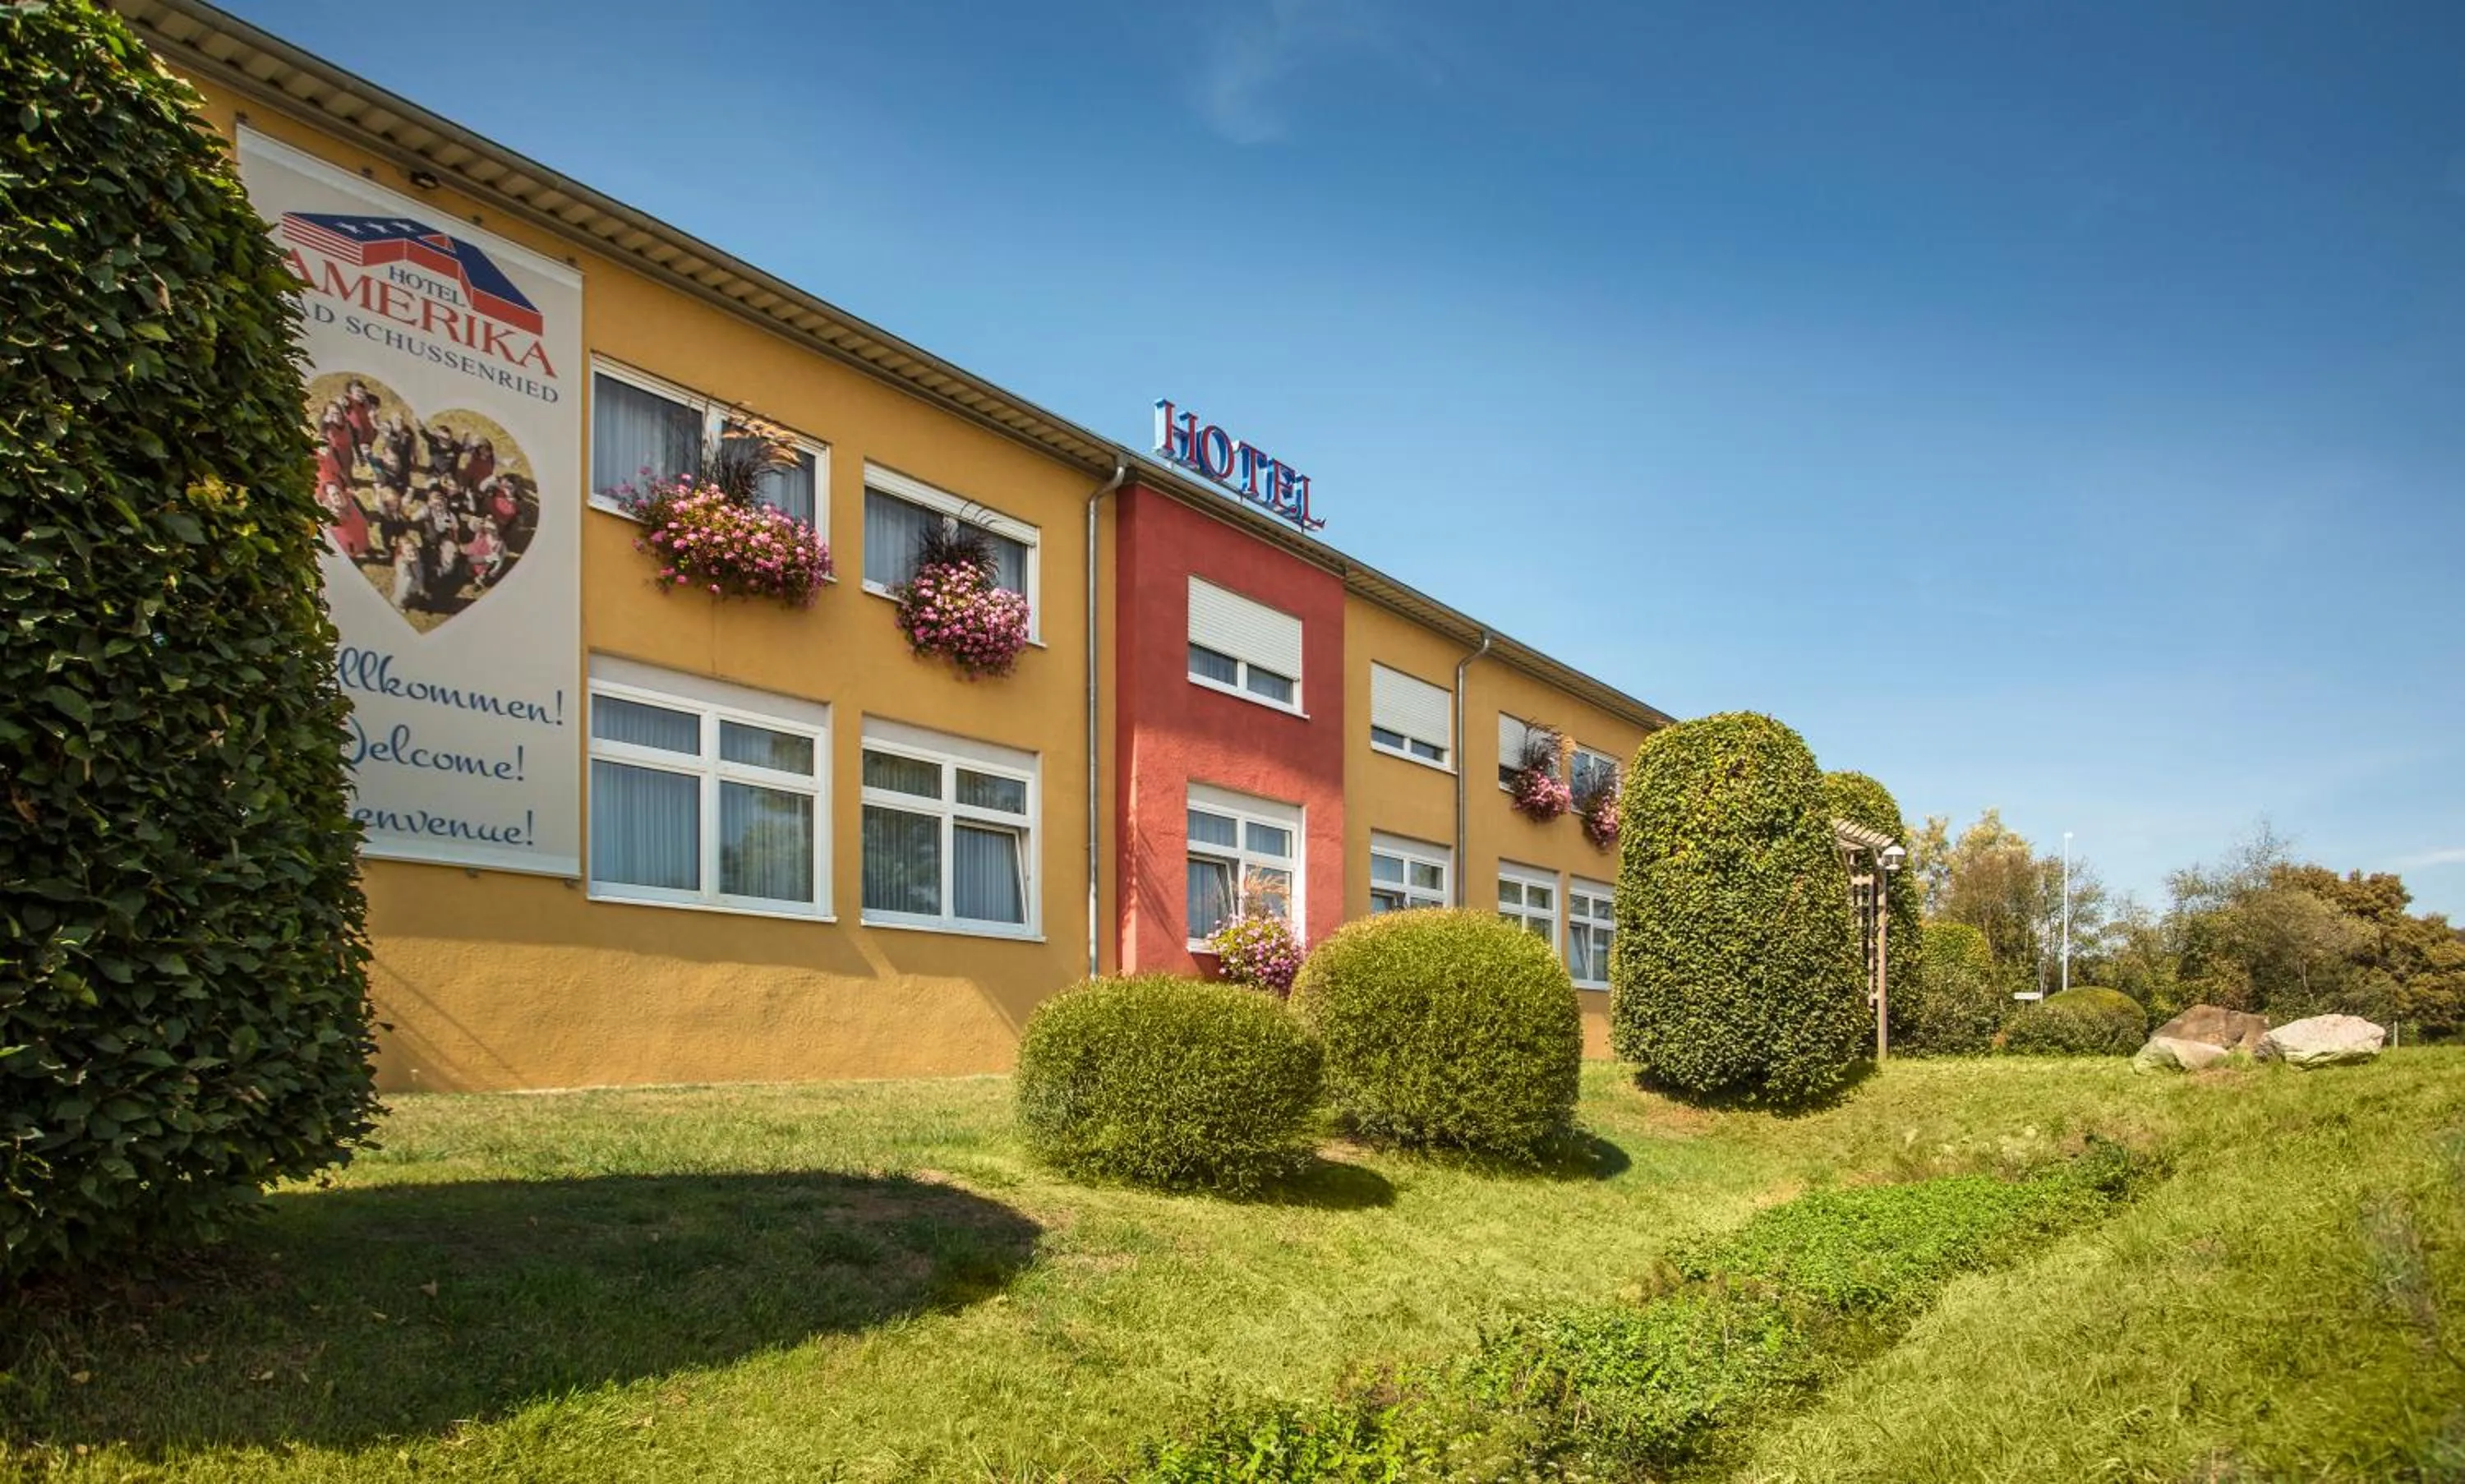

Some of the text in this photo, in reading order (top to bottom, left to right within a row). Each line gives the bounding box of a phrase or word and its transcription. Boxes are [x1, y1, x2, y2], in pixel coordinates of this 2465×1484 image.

[388, 265, 466, 308] HOTEL
[345, 315, 559, 404] SCHUSSENRIED
[1154, 398, 1329, 530] HOTEL
[338, 647, 563, 726] llkommen!
[352, 808, 533, 846] envenue!
